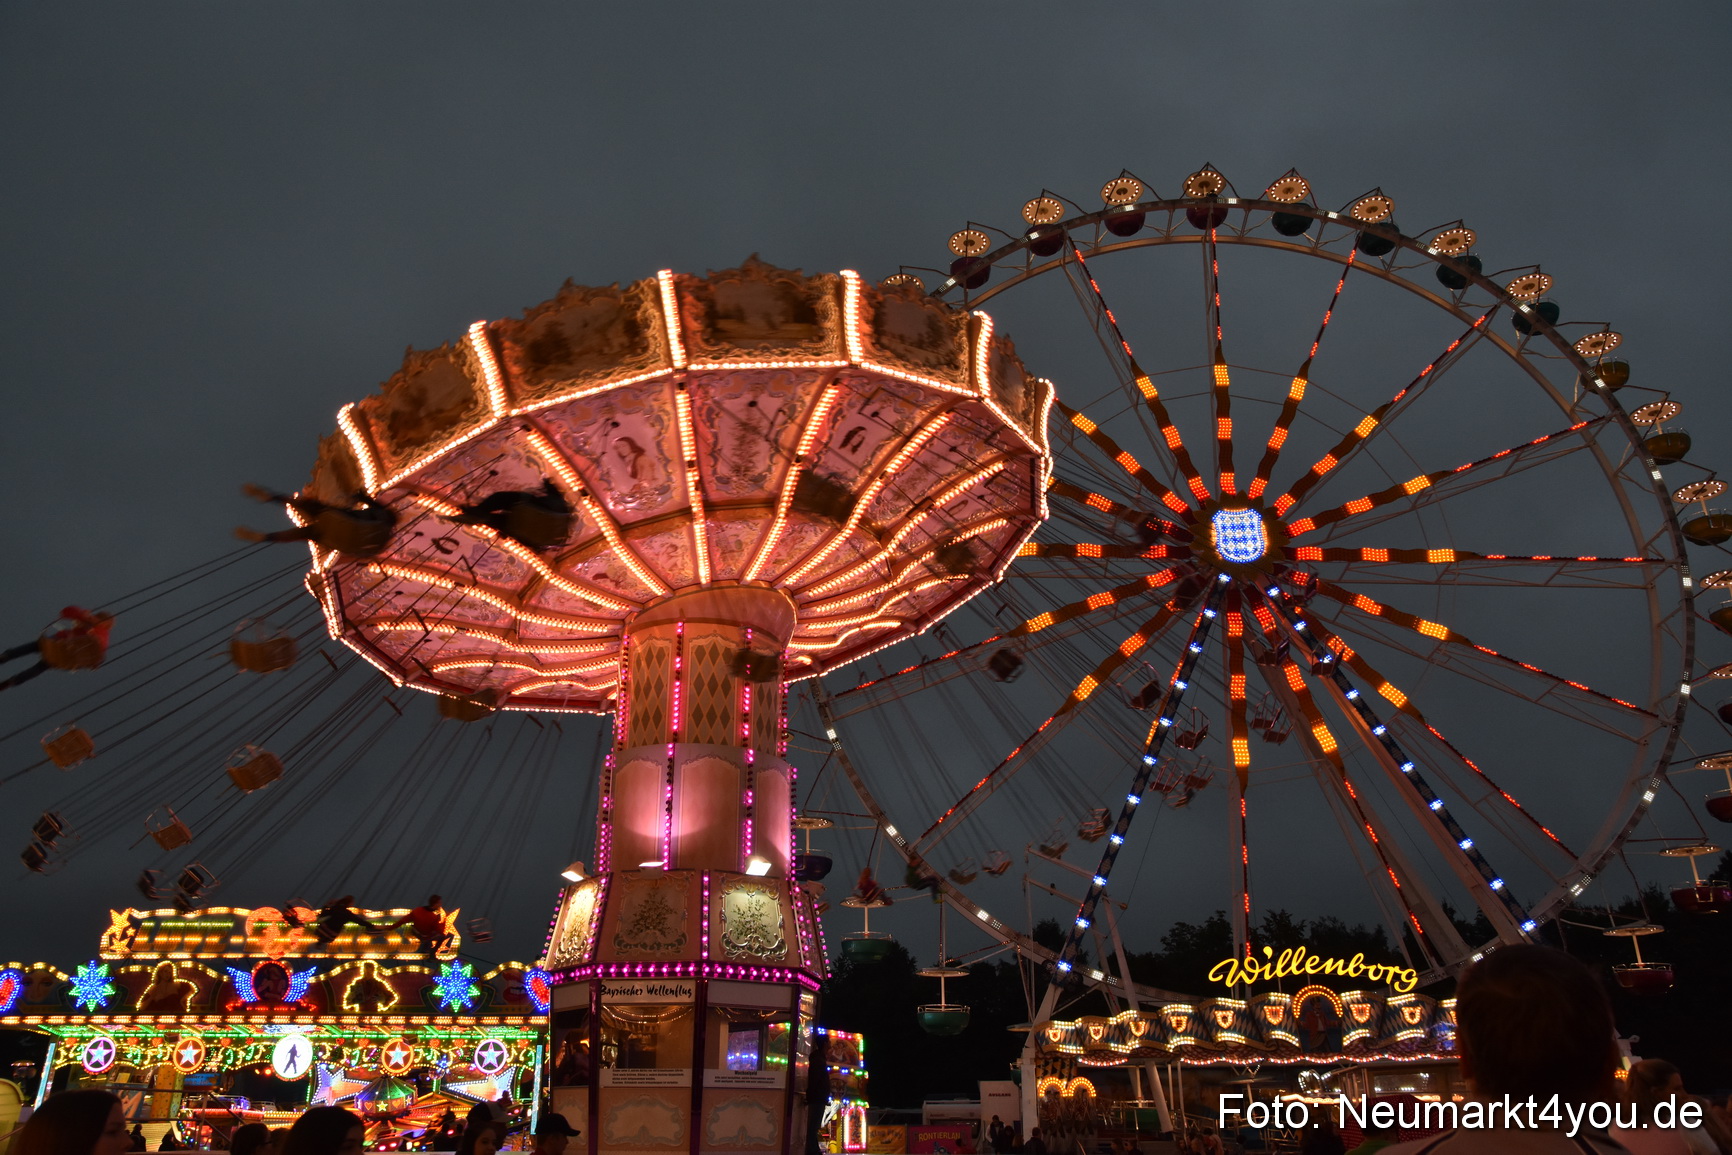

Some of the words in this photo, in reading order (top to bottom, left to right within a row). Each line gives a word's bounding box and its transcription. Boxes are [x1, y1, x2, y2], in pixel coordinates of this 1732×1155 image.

[1208, 945, 1419, 994] Willenborg
[600, 984, 643, 998] Bayrischer
[646, 984, 692, 998] Wellenflug
